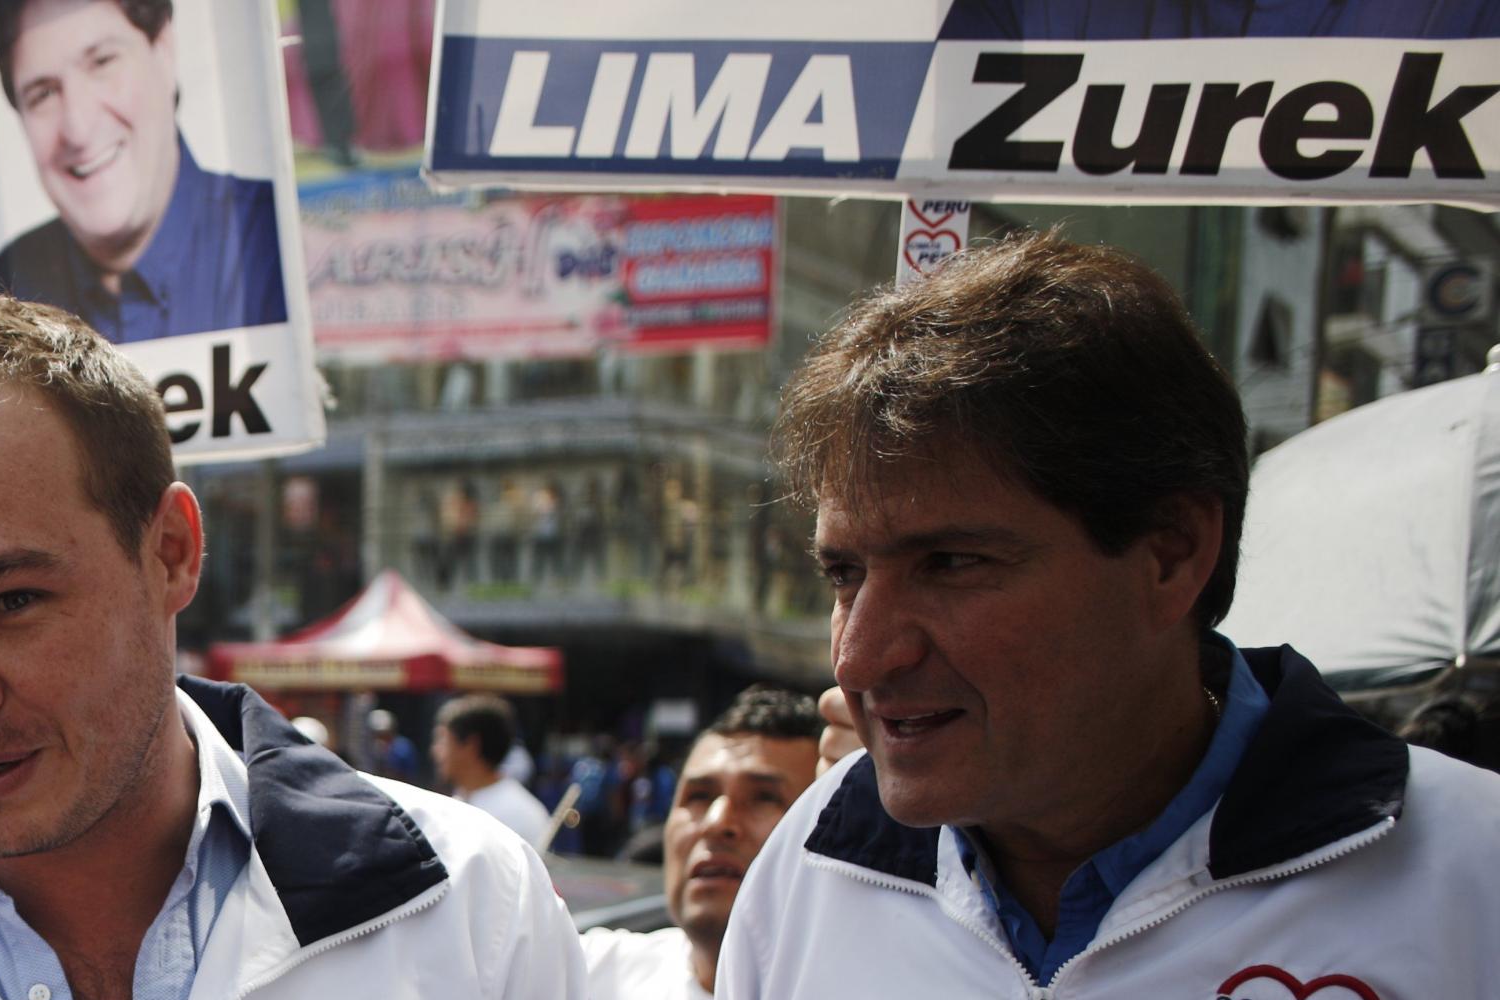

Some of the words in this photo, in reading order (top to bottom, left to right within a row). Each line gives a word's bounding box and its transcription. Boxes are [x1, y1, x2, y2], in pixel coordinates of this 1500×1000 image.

[489, 50, 860, 163] LIMA
[947, 51, 1500, 181] Zurek
[155, 343, 273, 444] ek
